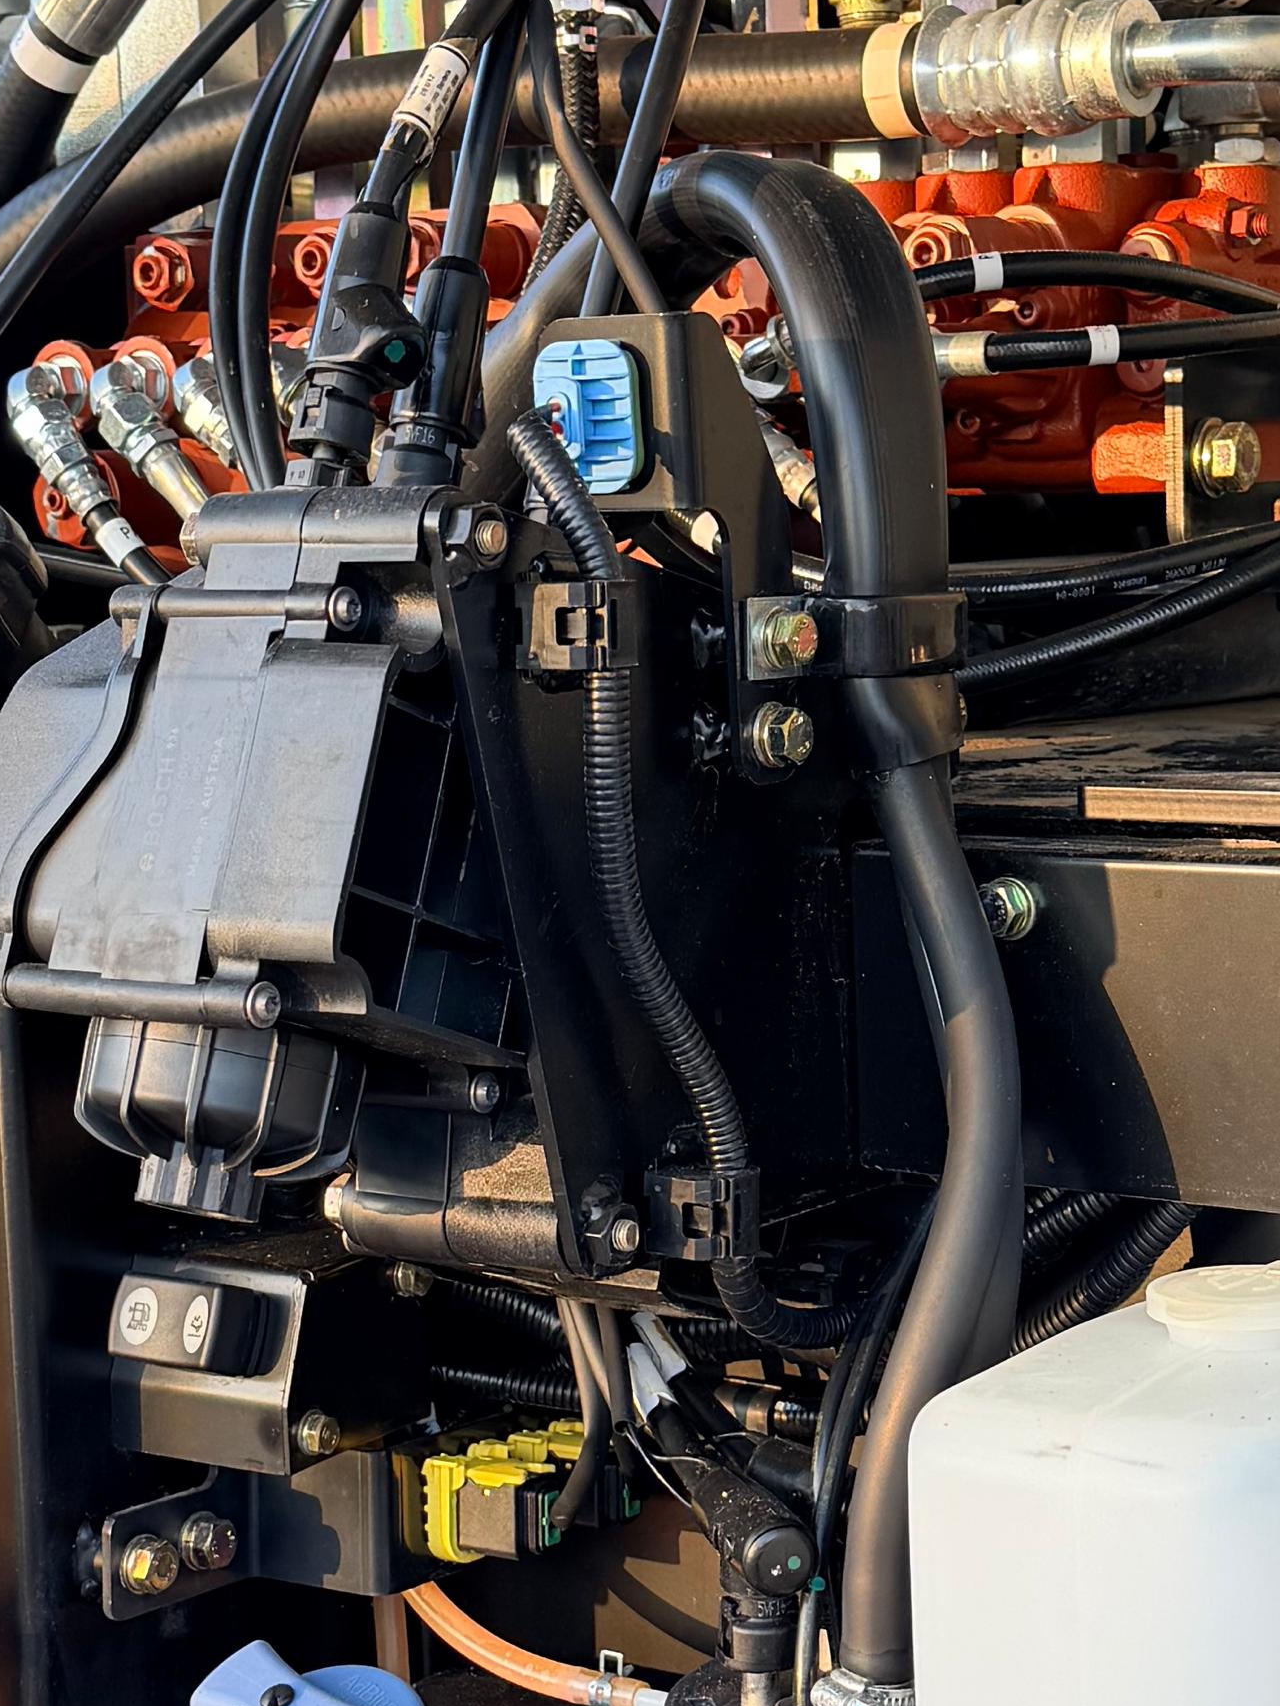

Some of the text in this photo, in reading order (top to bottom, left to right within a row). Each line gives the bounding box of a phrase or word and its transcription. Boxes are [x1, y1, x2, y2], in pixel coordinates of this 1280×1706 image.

[120, 526, 130, 539] P
[144, 757, 175, 846] BOSCH
[200, 736, 225, 809] AUSTRIA
